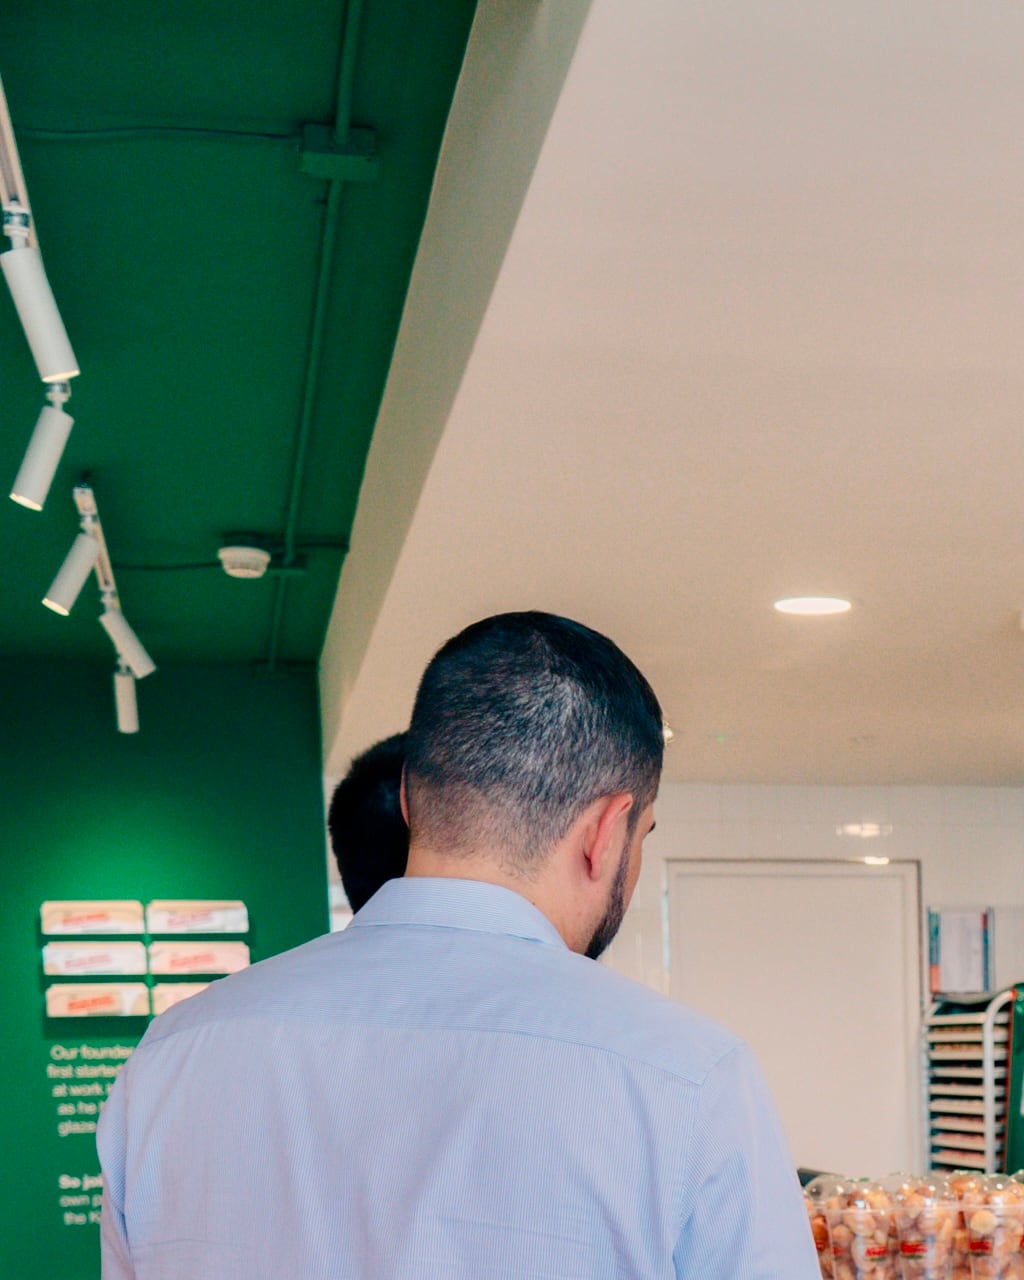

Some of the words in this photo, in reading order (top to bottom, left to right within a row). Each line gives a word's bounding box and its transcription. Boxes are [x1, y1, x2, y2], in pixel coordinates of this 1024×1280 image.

[51, 1045, 77, 1060] Our
[47, 1064, 73, 1078] first
[52, 1084, 67, 1097] at
[69, 1083, 103, 1096] work
[58, 1103, 75, 1115] as
[77, 1102, 96, 1114] he
[59, 1175, 81, 1188] So
[64, 1212, 86, 1225] the
